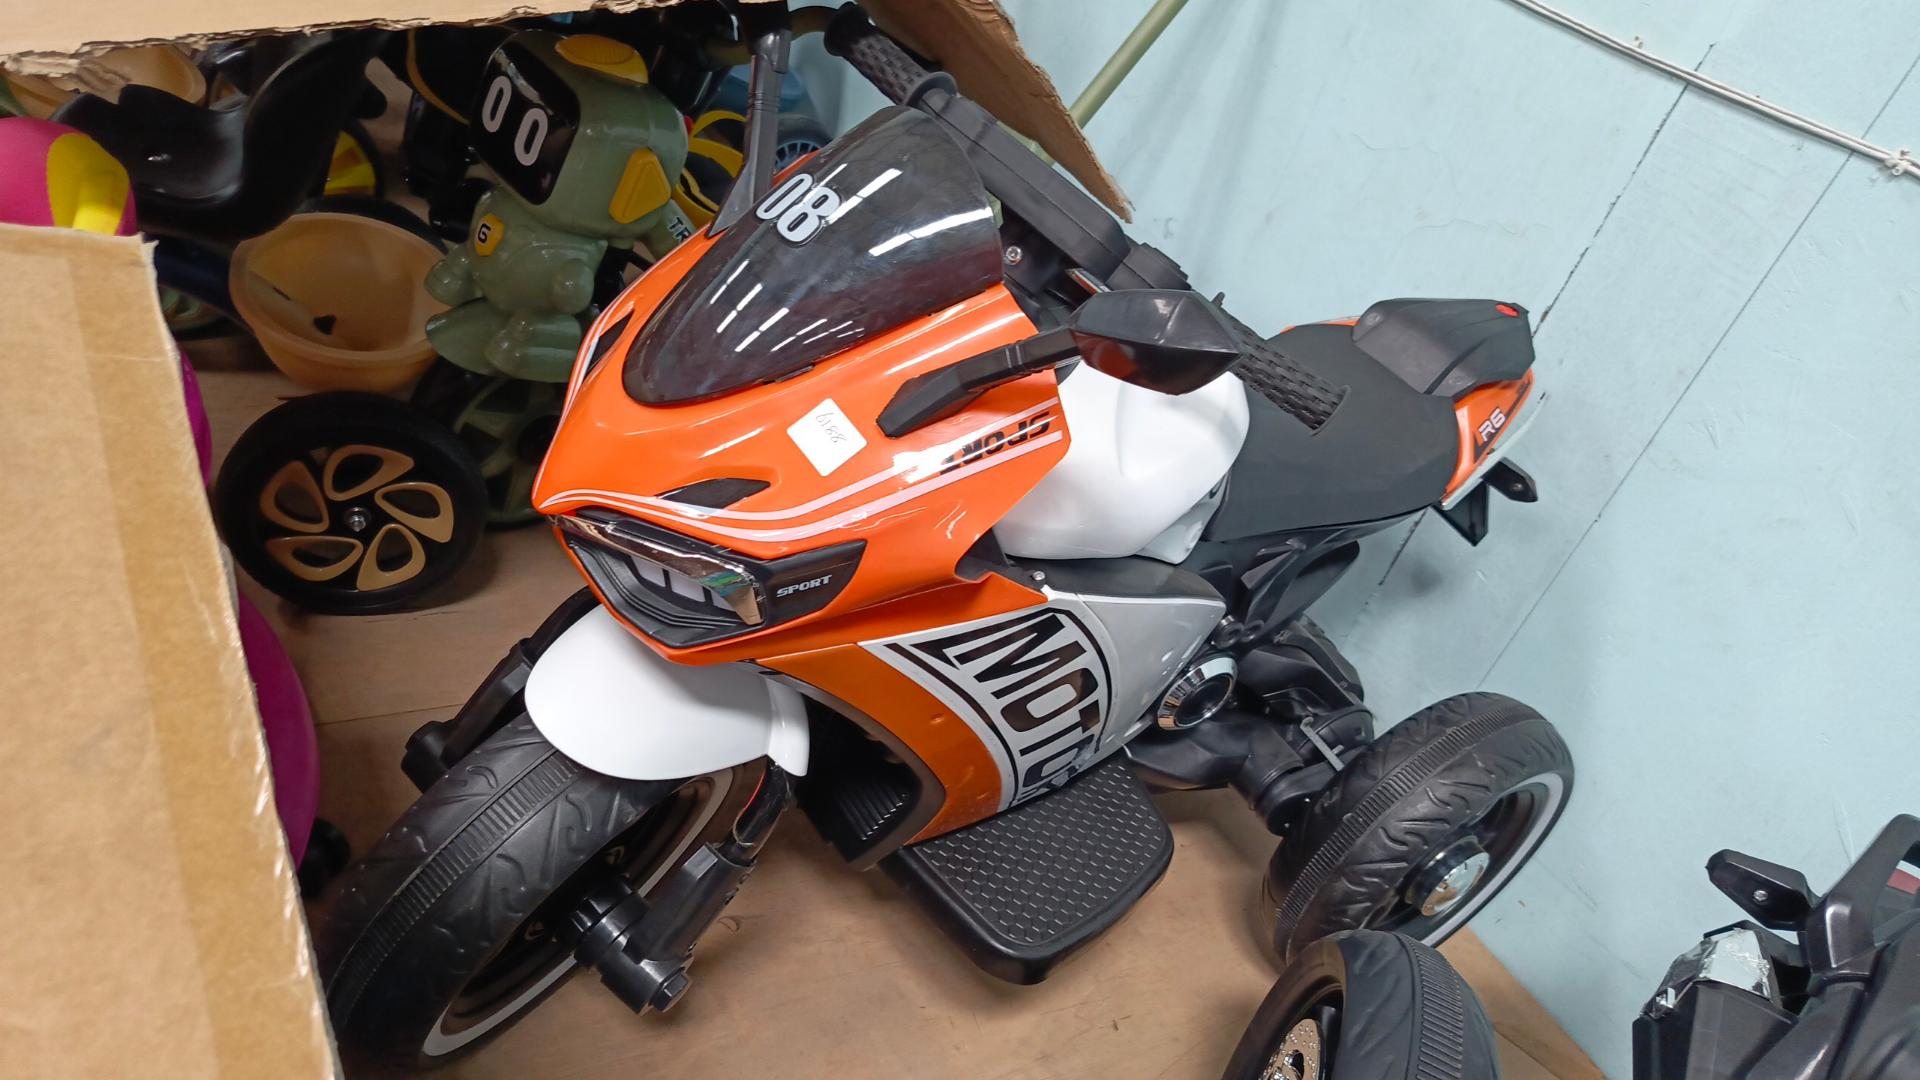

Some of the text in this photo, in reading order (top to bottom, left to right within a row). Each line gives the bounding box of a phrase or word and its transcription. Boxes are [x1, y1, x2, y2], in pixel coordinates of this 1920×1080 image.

[755, 172, 841, 243] 08
[1478, 407, 1506, 442] R6
[776, 574, 833, 598] SPORT
